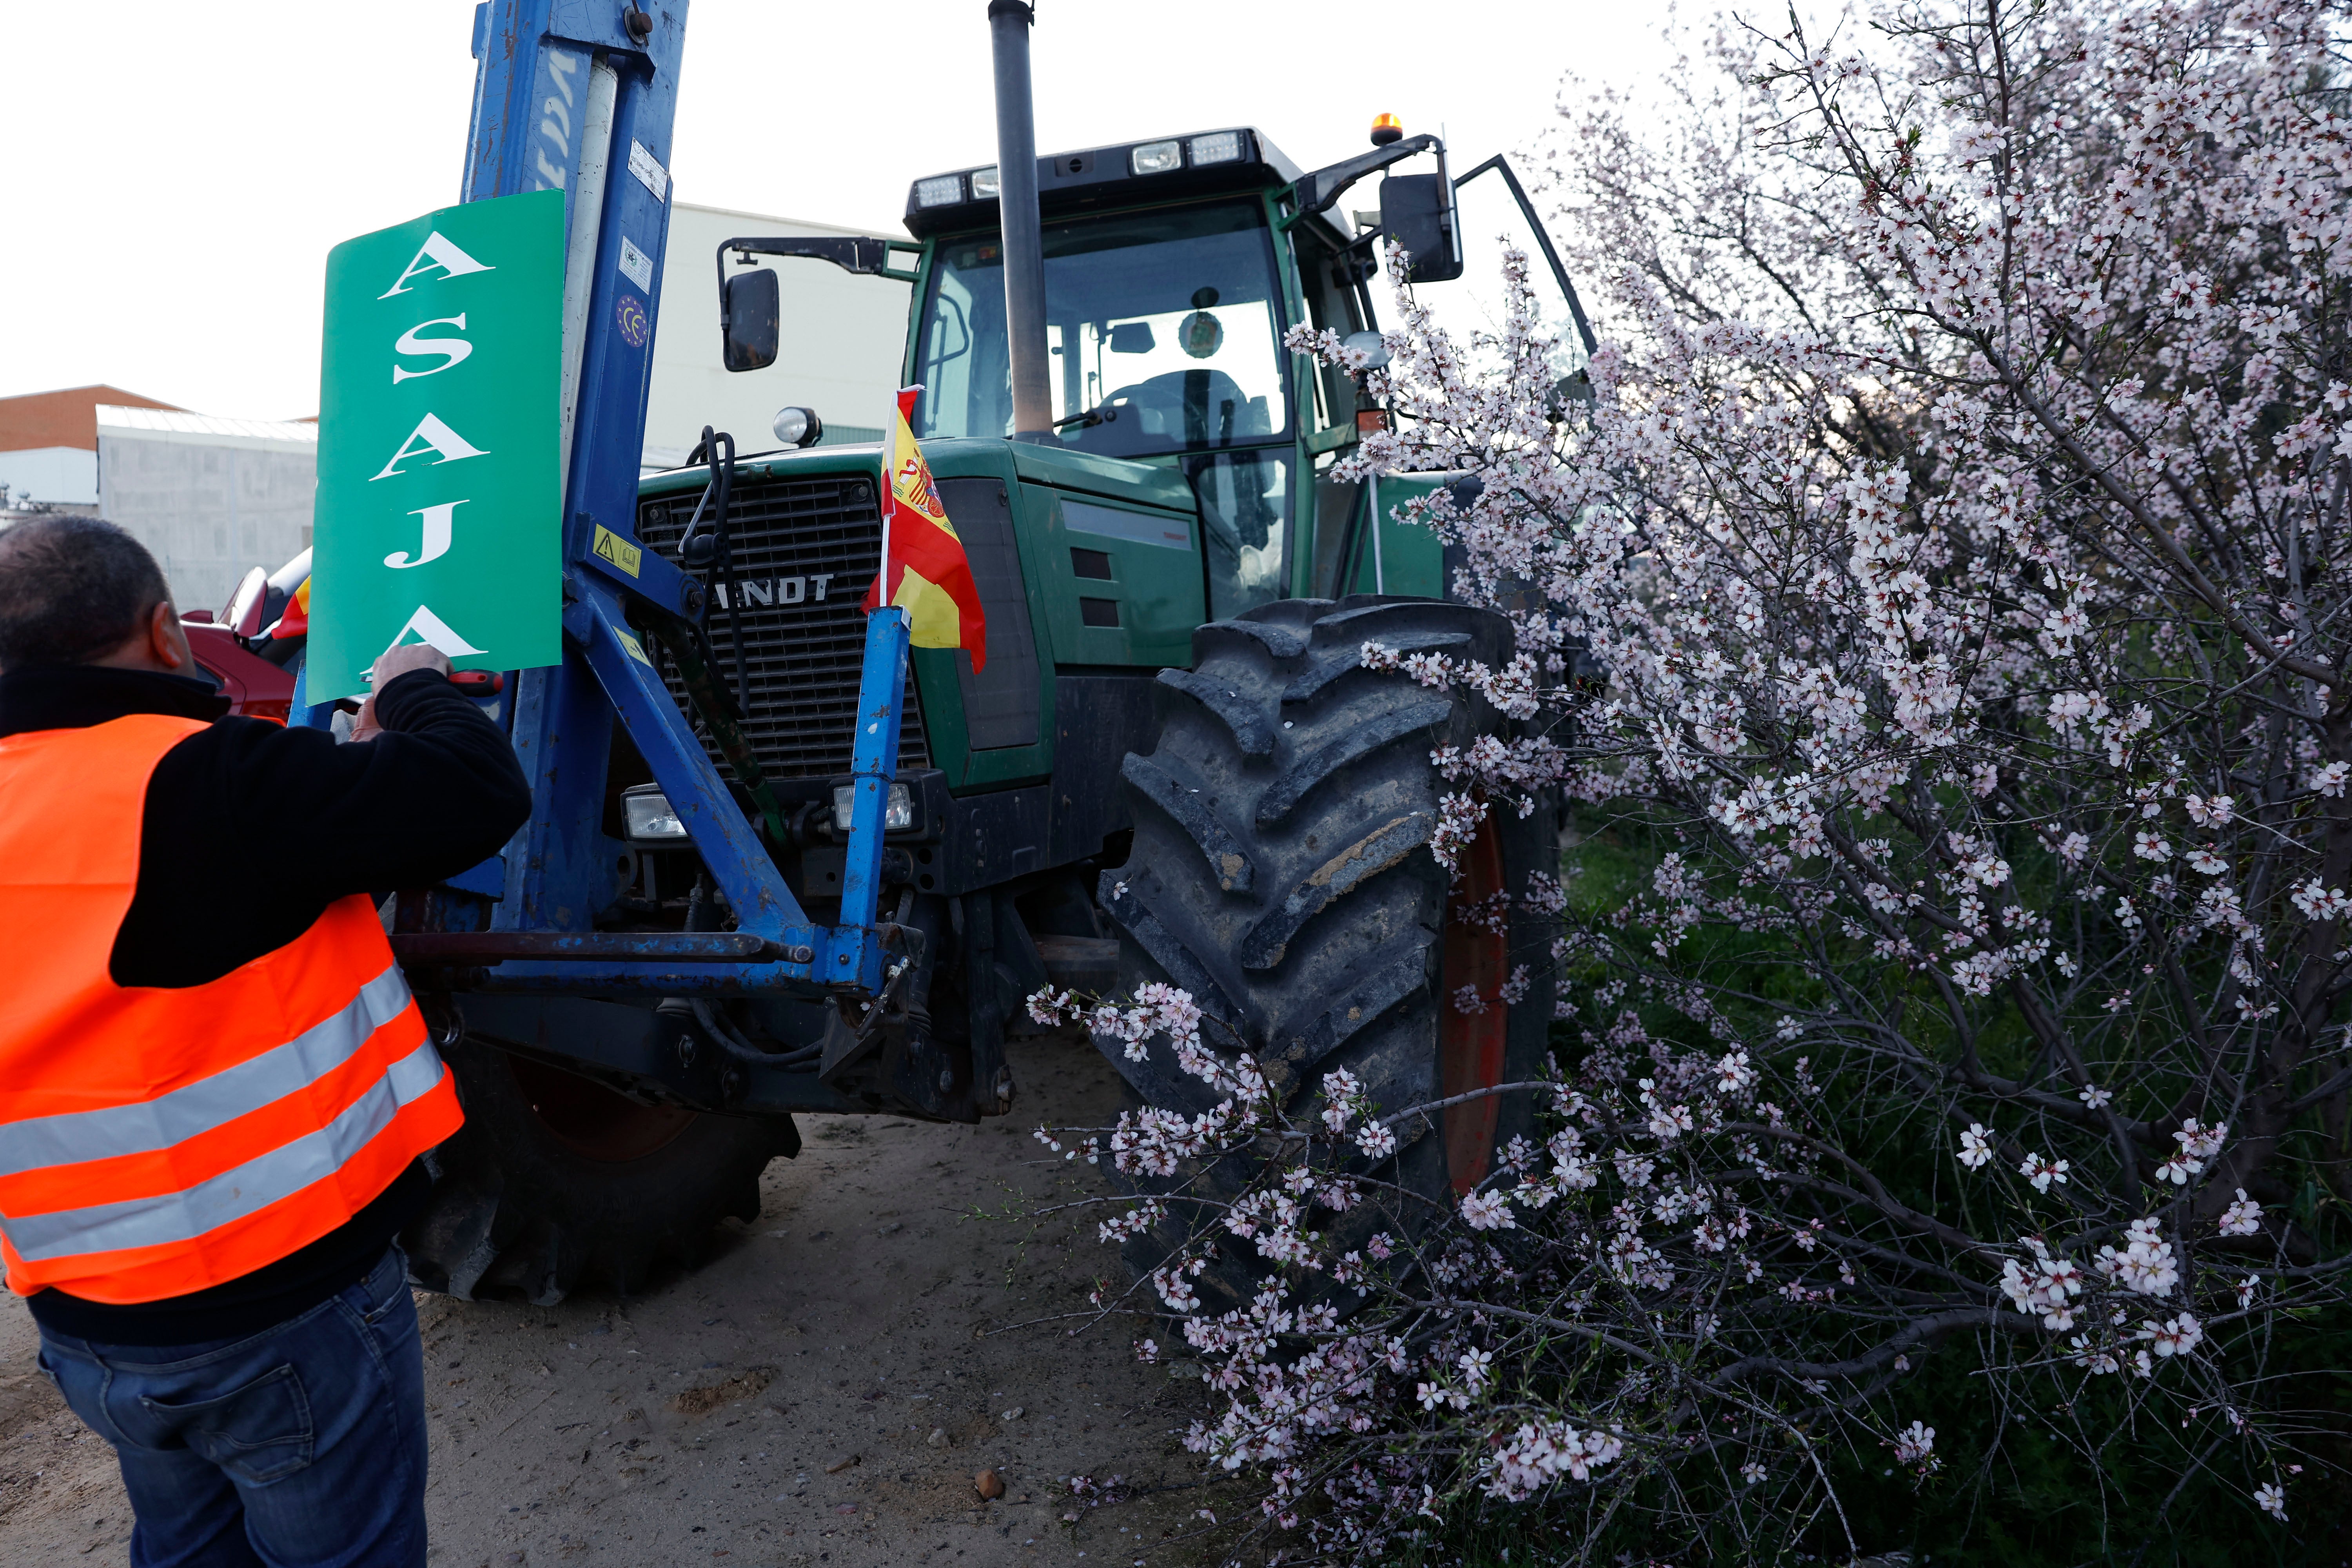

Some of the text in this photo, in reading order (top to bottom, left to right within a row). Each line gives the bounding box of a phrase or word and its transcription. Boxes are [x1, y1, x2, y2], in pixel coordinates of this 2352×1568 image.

[624, 307, 642, 339] CE
[360, 231, 496, 675] ASAJA
[704, 574, 834, 608] ENDT
